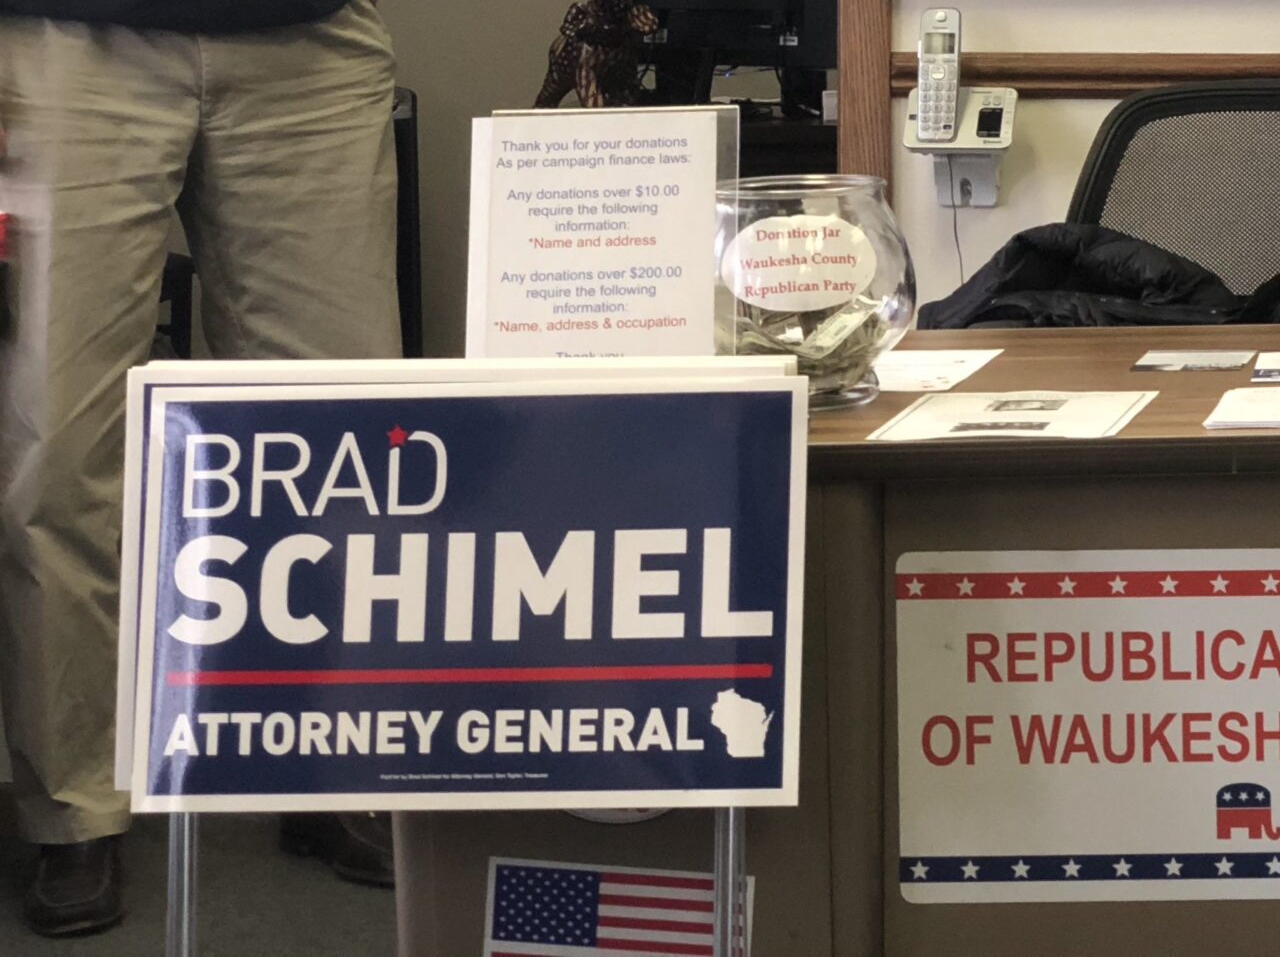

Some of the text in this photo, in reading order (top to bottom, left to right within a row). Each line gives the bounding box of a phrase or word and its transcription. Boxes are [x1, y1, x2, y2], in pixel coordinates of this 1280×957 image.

[501, 137, 688, 154] Thank you for your donations
[496, 153, 692, 170] As per campaign finance laws:
[507, 184, 680, 203] Any donations over $10.00
[528, 202, 659, 218] require the following
[554, 220, 631, 232] information:
[821, 226, 841, 241] Jar
[576, 236, 601, 248] and
[605, 235, 657, 247] address
[740, 252, 859, 271] Waukesha County
[501, 265, 682, 285] Any donations over $200.00
[526, 283, 657, 300] require the following
[744, 279, 857, 299] Republican Party
[553, 301, 628, 314] information:
[546, 318, 599, 331] address
[602, 317, 613, 328] &
[616, 316, 688, 330] occupation
[181, 428, 448, 518] BRAD
[166, 527, 774, 646] SCHIMEL
[163, 706, 705, 758] ATTORNEY GENERAL
[921, 715, 993, 767] OF
